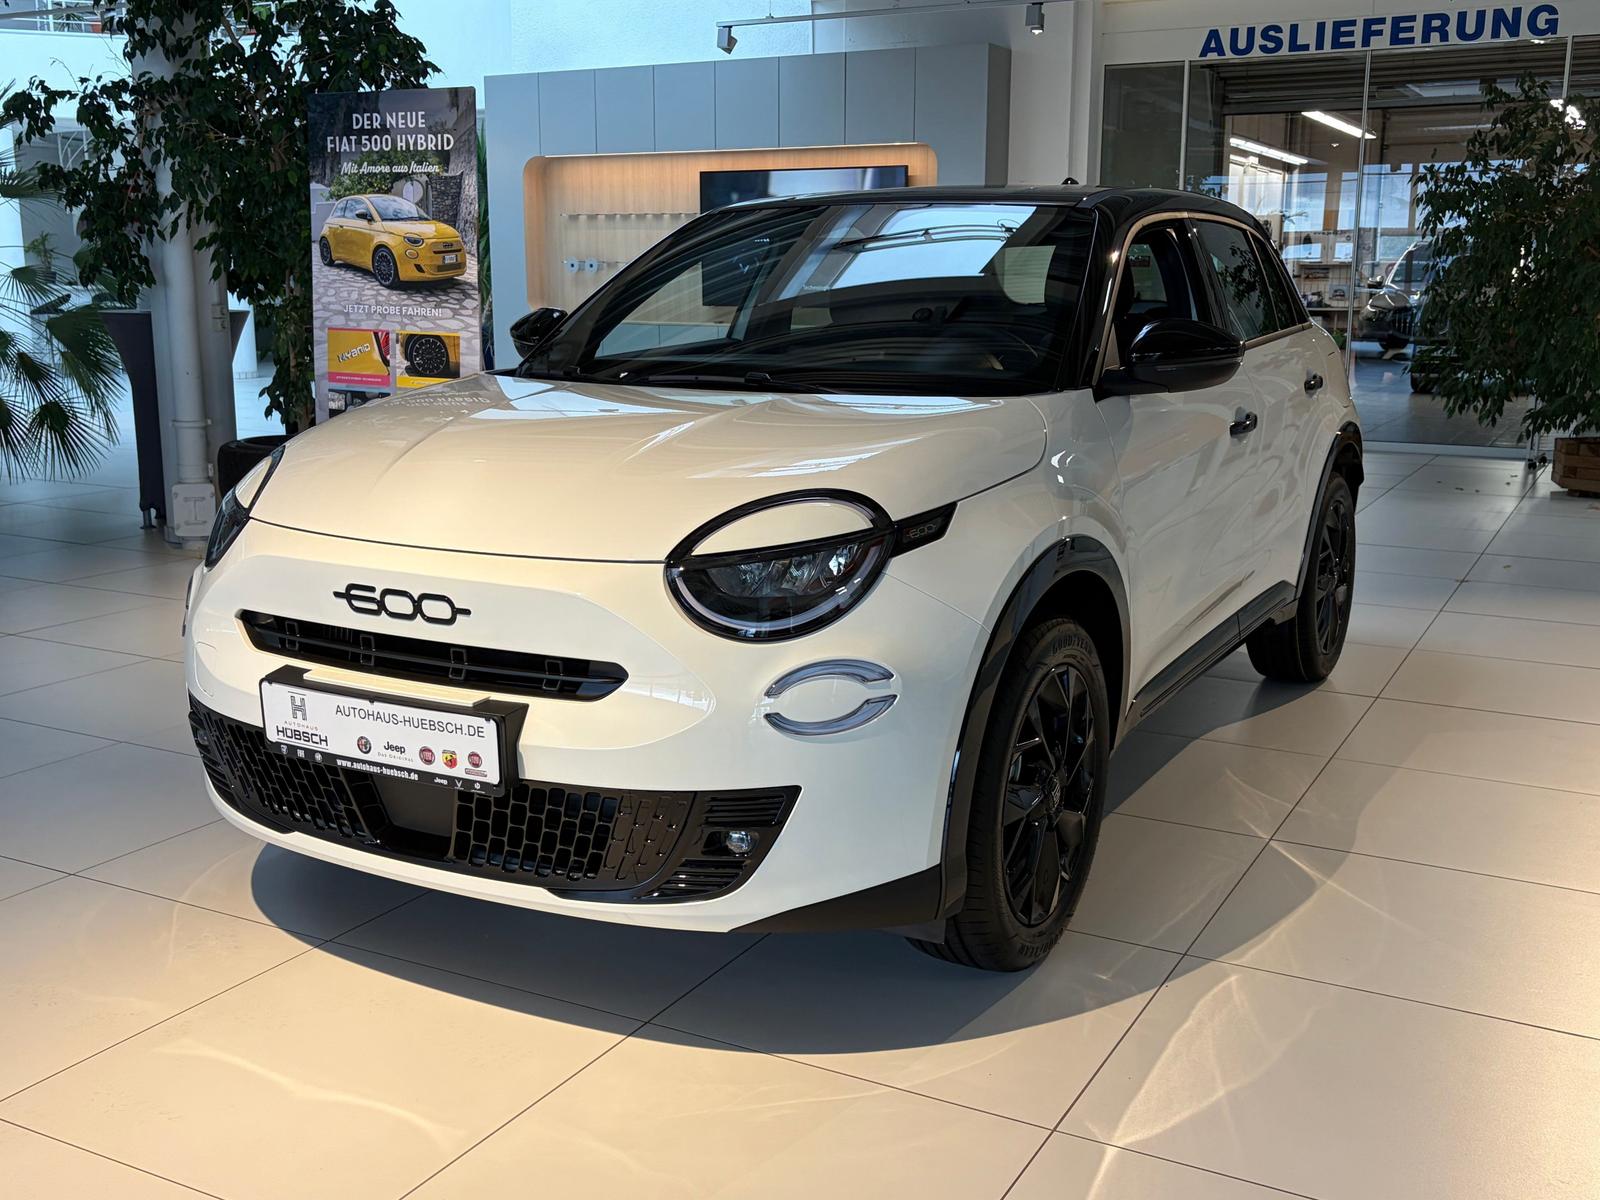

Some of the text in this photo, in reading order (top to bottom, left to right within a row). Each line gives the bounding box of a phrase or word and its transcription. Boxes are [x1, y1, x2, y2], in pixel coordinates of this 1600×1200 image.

[1199, 4, 1559, 58] AUSLIEFERUNG
[352, 111, 426, 130] DER NEUE
[327, 134, 454, 152] FIAT 500 HYBRID
[341, 161, 440, 175] Mit Amore aus Italien
[344, 304, 442, 317] JETZT PROBE FAHREN!
[339, 583, 465, 625] 600
[284, 720, 319, 732] AUTOHAUS
[336, 705, 486, 738] AUTOHAUS-HUEBSCH.DE
[384, 741, 406, 755] Jeep
[336, 758, 419, 781] www.autohaus-huebsch.de
